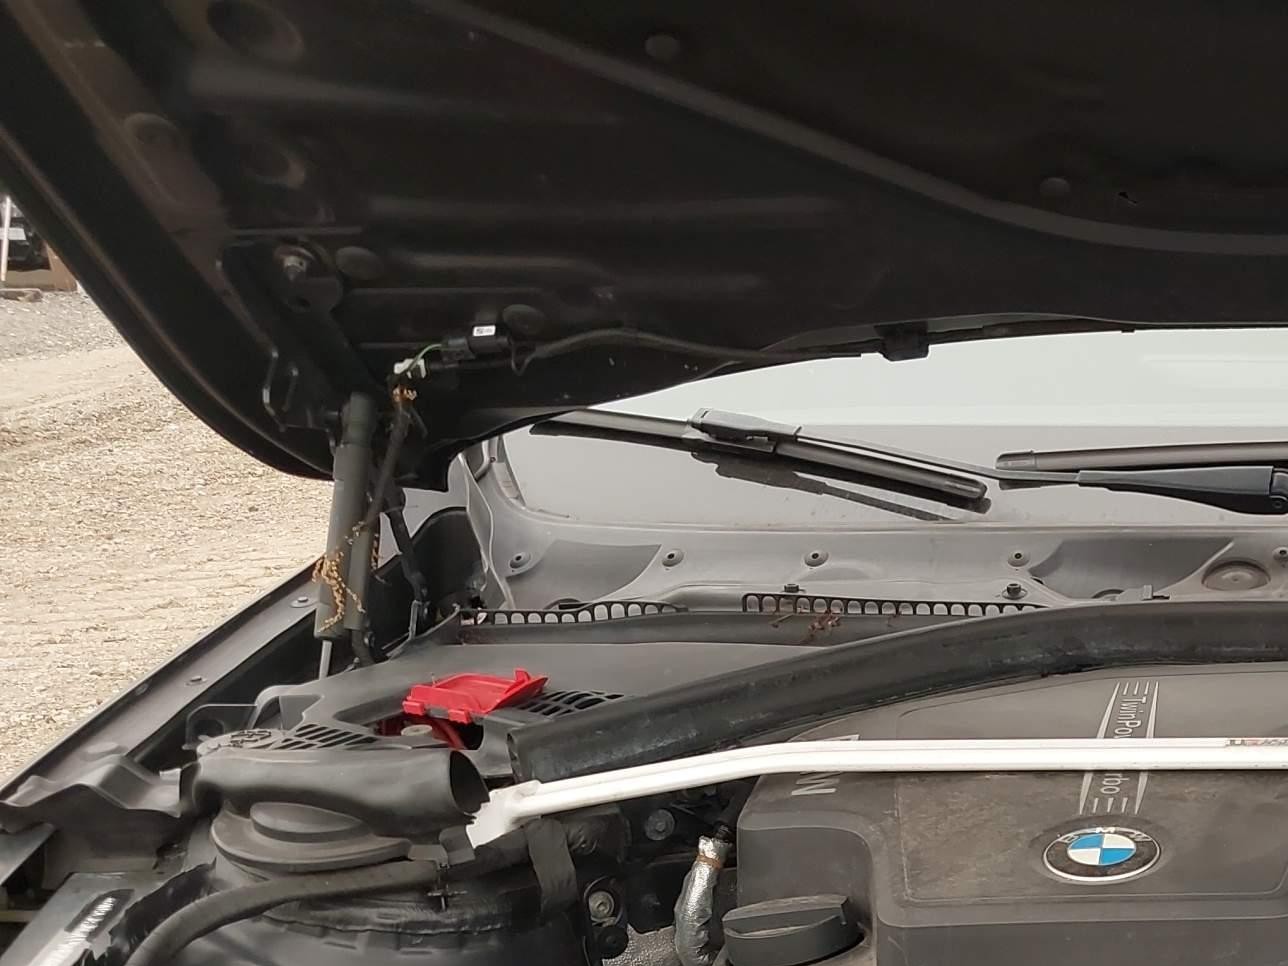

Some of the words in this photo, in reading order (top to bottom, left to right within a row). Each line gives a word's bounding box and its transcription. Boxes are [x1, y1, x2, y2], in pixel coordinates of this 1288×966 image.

[1114, 696, 1147, 740] TwinPo
[1099, 772, 1129, 795] rbo
[1057, 826, 1153, 844] BMW
